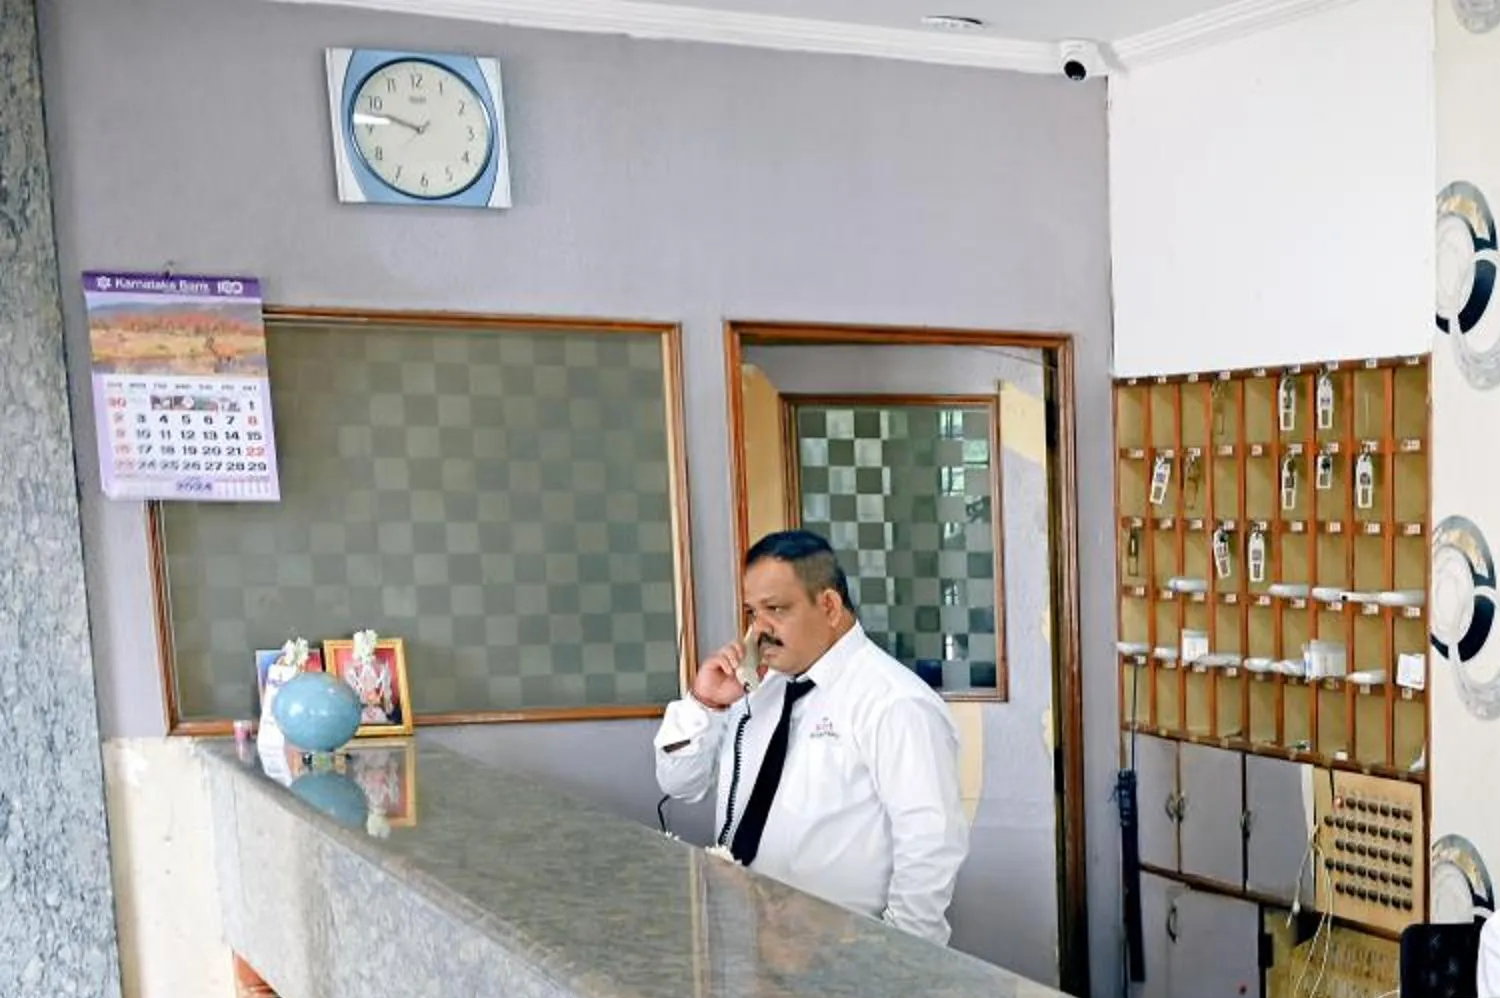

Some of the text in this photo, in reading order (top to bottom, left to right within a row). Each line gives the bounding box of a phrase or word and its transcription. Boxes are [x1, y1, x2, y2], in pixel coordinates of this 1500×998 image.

[387, 78, 397, 92] 11
[410, 73, 423, 88] 12
[368, 96, 383, 110] 10
[115, 277, 176, 291] Karnataka
[136, 429, 151, 439] 10
[160, 429, 171, 440] 11
[181, 430, 195, 440] 12
[203, 431, 218, 441] 13
[225, 431, 240, 441] 14
[247, 431, 263, 441] 15
[138, 445, 152, 455] 17
[160, 446, 176, 455] 18
[182, 446, 197, 456] 19
[202, 446, 222, 456] 20
[225, 446, 241, 456] 21
[246, 447, 265, 457] 22
[182, 461, 201, 472] 26
[204, 461, 222, 472] 27
[226, 462, 245, 472] 28
[247, 462, 267, 472] 29
